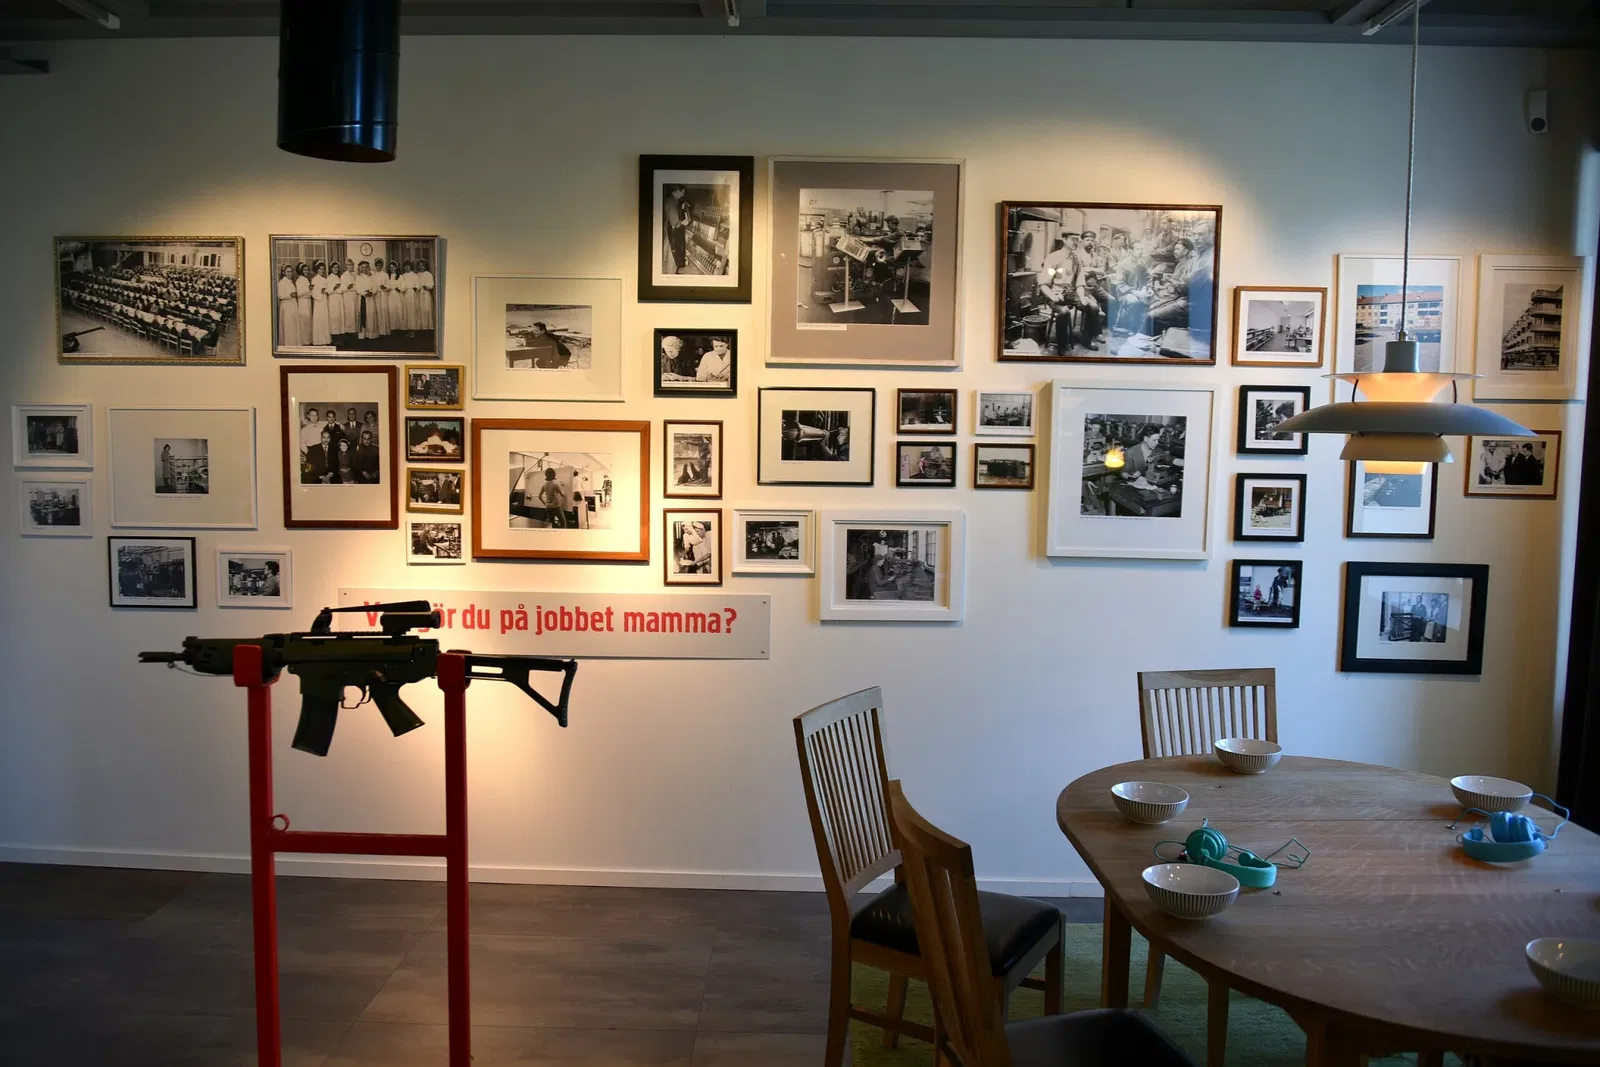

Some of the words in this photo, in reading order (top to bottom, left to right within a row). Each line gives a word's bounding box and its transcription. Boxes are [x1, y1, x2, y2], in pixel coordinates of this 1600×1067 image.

[462, 604, 491, 630] du
[500, 604, 529, 635] på
[535, 604, 615, 636] jobbet
[623, 607, 738, 634] mamma?
